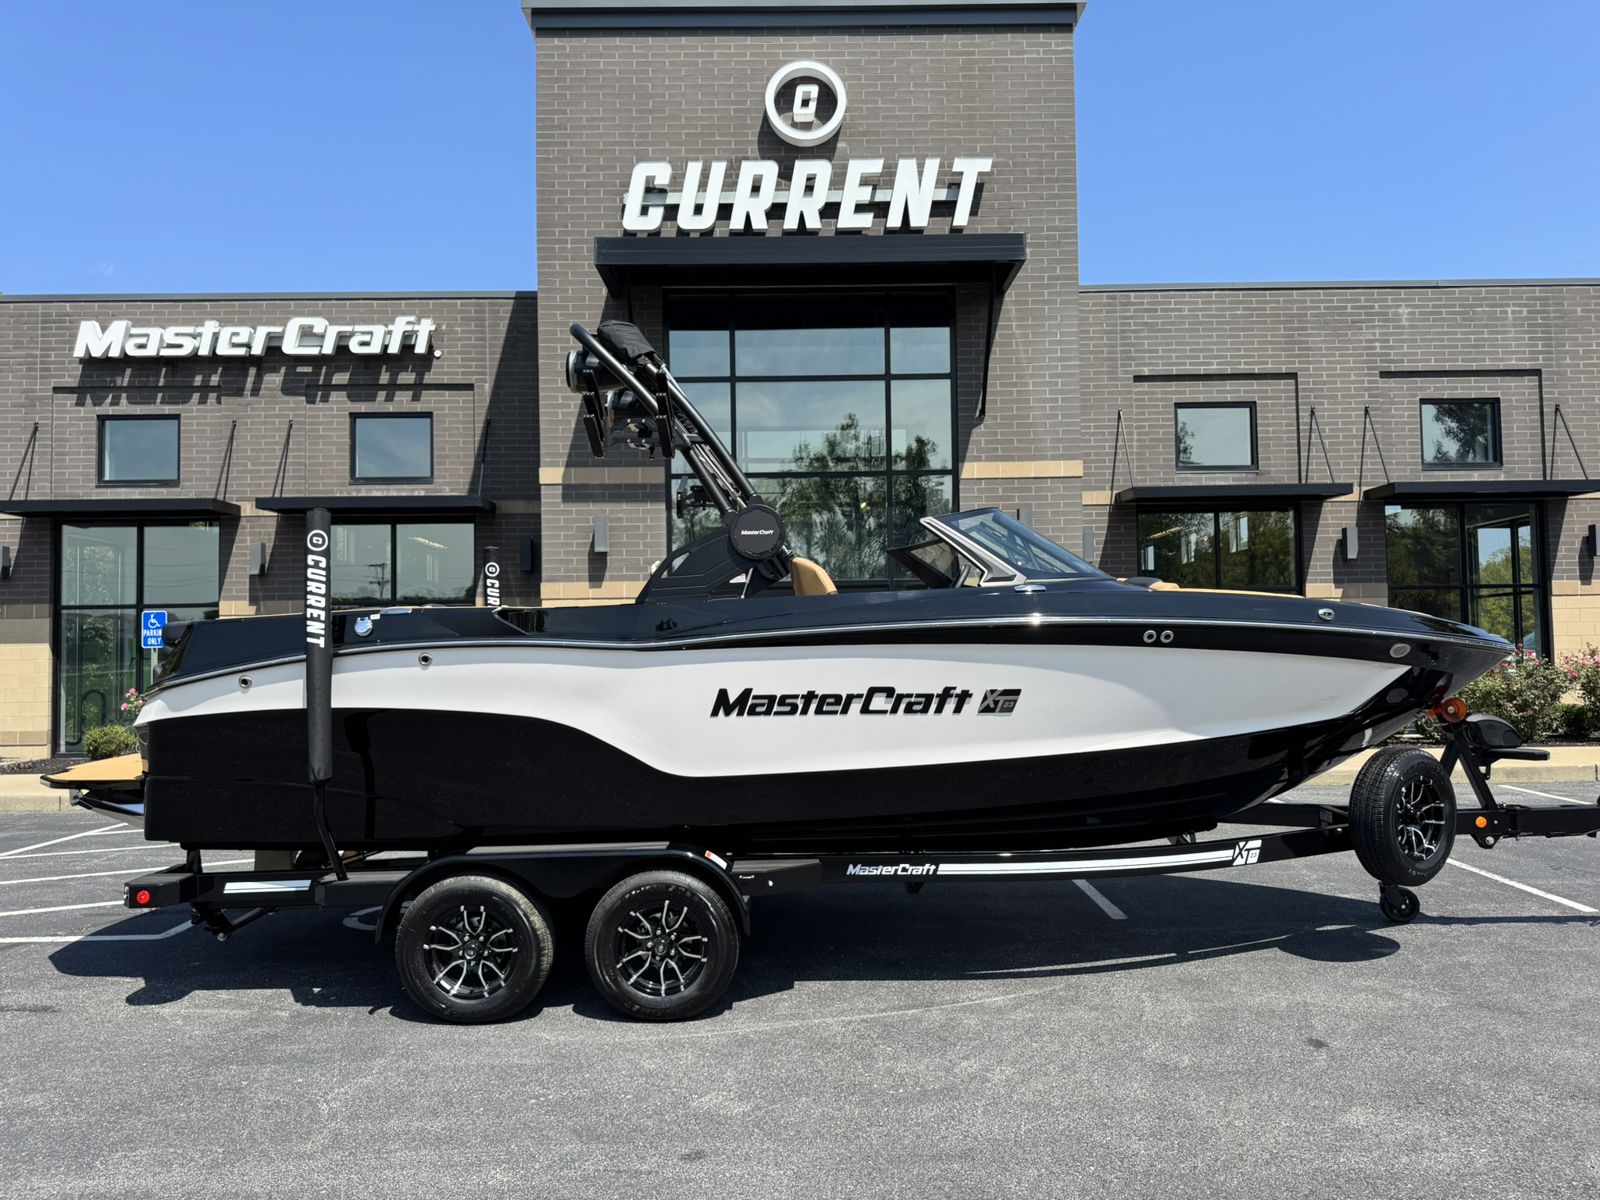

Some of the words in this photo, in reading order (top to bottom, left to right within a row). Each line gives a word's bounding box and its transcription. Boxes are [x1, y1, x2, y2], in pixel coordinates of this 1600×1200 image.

[622, 157, 993, 231] CURRENT
[306, 554, 327, 648] CURRENT
[143, 629, 162, 637] PARKIN
[147, 637, 161, 645] ONLY
[710, 686, 973, 716] MasterCraft
[846, 863, 936, 875] MasterCraft
